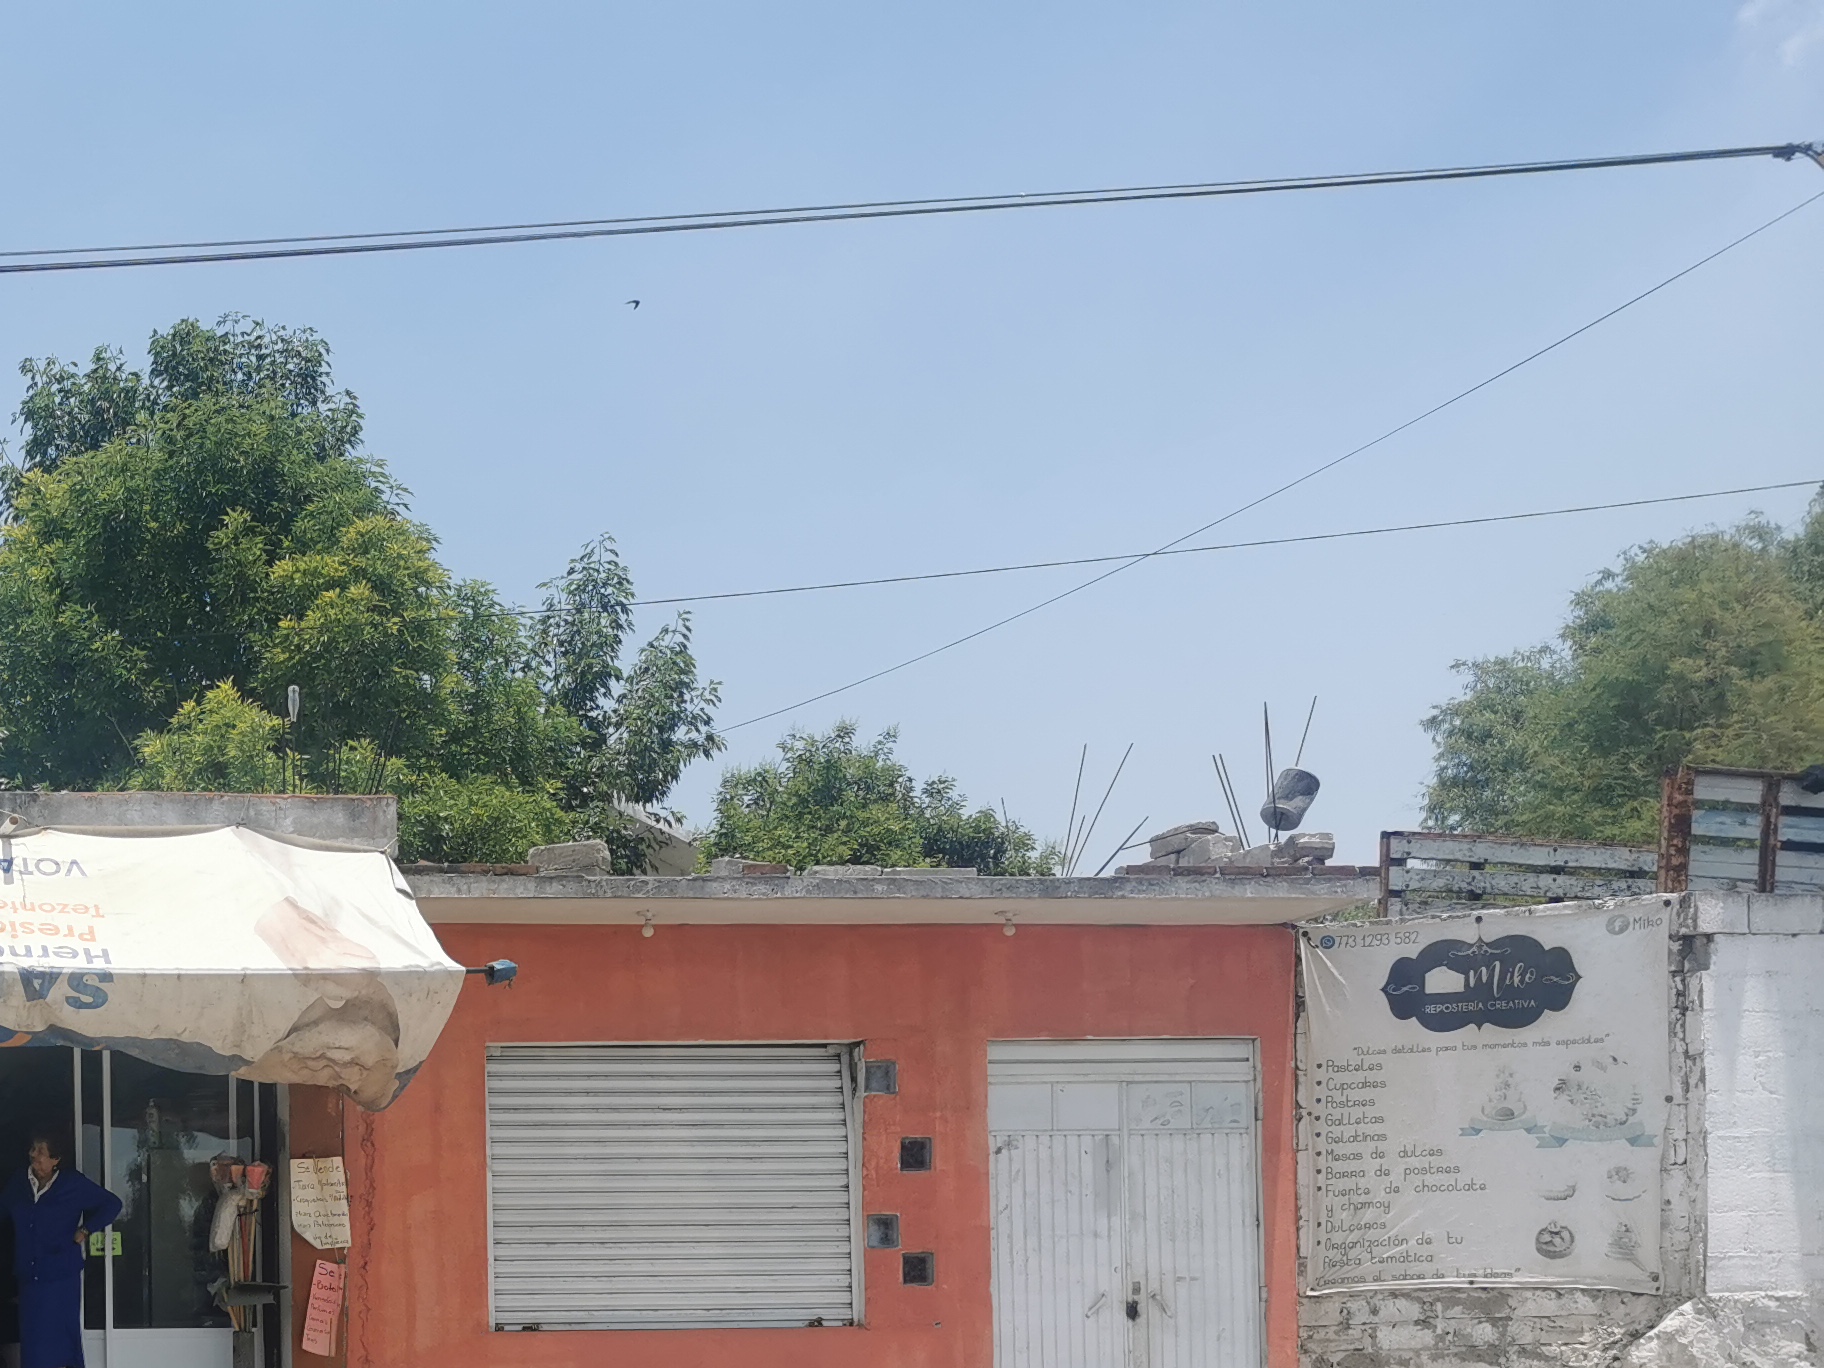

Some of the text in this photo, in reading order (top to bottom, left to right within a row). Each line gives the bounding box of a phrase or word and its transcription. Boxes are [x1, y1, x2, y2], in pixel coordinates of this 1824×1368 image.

[1632, 915, 1664, 931] Miko
[1335, 930, 1420, 949] 773 1293 582
[1469, 960, 1536, 999] Miko
[1424, 999, 1537, 1015] REPOSTERÍA CREATIVA
[1391, 1043, 1432, 1055] detalles
[1436, 1044, 1457, 1057] para
[1462, 1040, 1478, 1052] tus
[1481, 1038, 1528, 1050] momentos
[1531, 1036, 1551, 1048] más
[1325, 1058, 1383, 1073] Pasteles
[1325, 1076, 1388, 1096] Cupcakes
[1324, 1098, 1376, 1110] Postres
[1324, 1114, 1385, 1127] Galletas
[1325, 1131, 1388, 1145] Gelatinas
[1326, 1144, 1443, 1162] Mesas de dulces
[1326, 1161, 1461, 1183] Barra de postres
[1325, 1178, 1487, 1198] Fuente de chocolate
[1325, 1198, 1391, 1217] y chamoy
[1324, 1230, 1464, 1257] Organización de tu
[1322, 1251, 1433, 1270] fiesta temática
[1372, 1269, 1386, 1281] el
[1391, 1268, 1426, 1281] sabor
[1431, 1267, 1446, 1279] de
